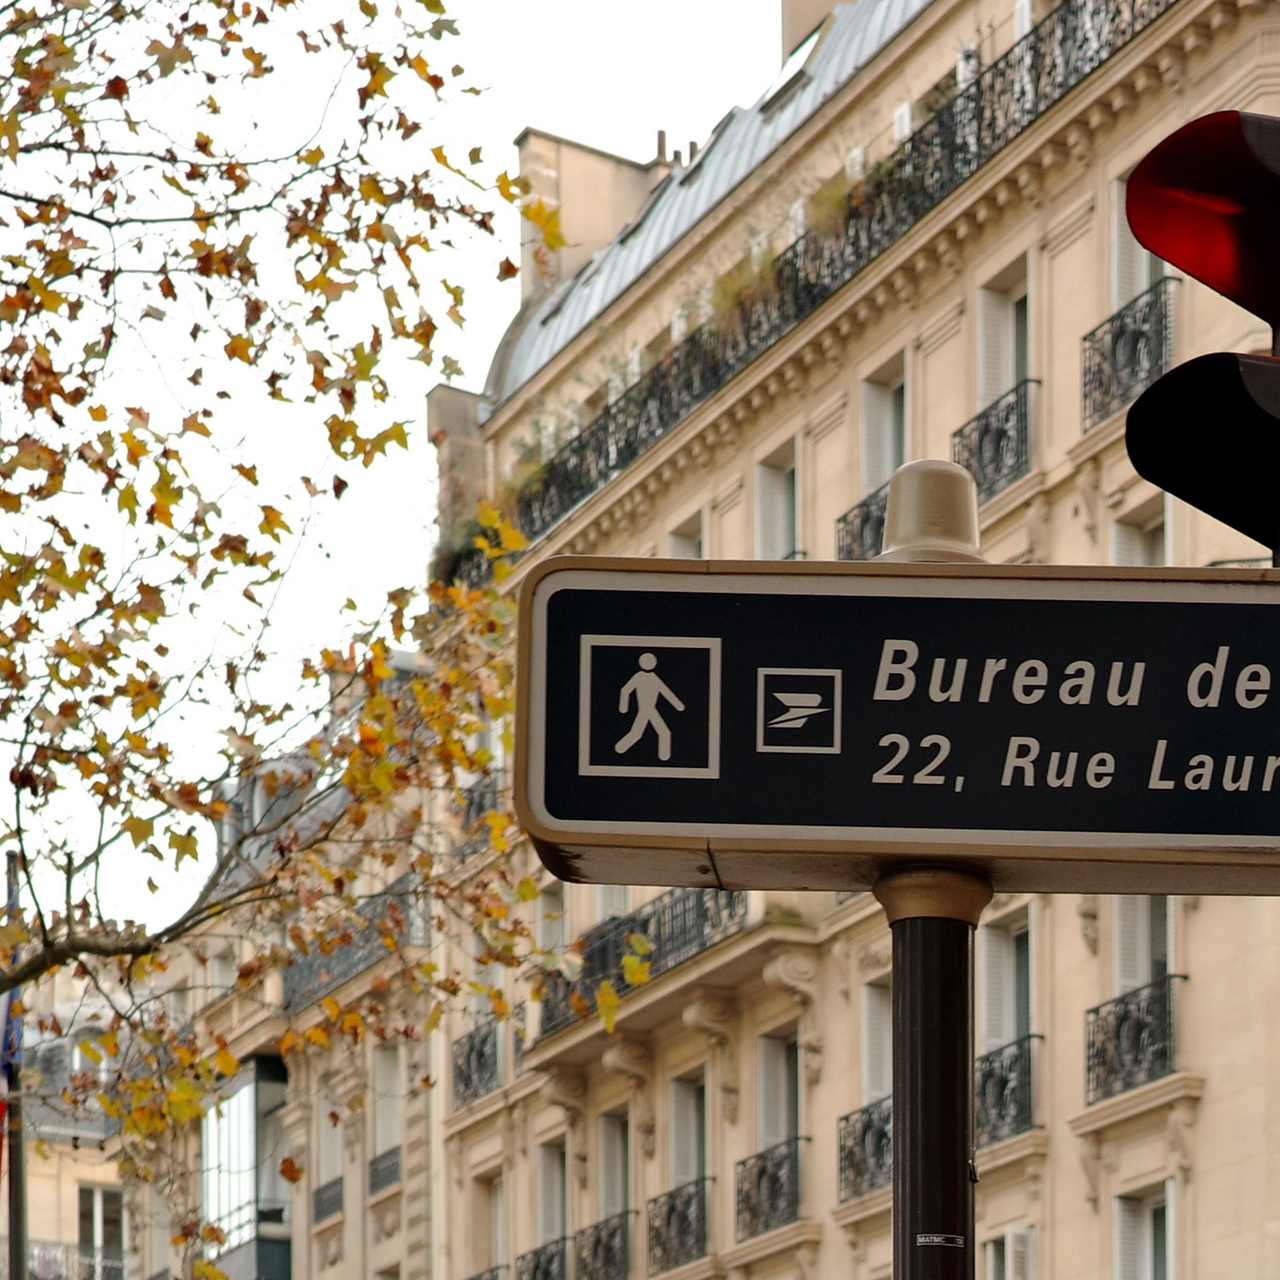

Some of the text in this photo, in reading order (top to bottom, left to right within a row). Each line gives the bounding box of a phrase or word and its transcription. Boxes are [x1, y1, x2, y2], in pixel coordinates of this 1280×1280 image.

[872, 638, 1146, 706] Bureau
[1186, 645, 1272, 709] de
[871, 733, 966, 793] 22,
[1000, 736, 1116, 789] Rue
